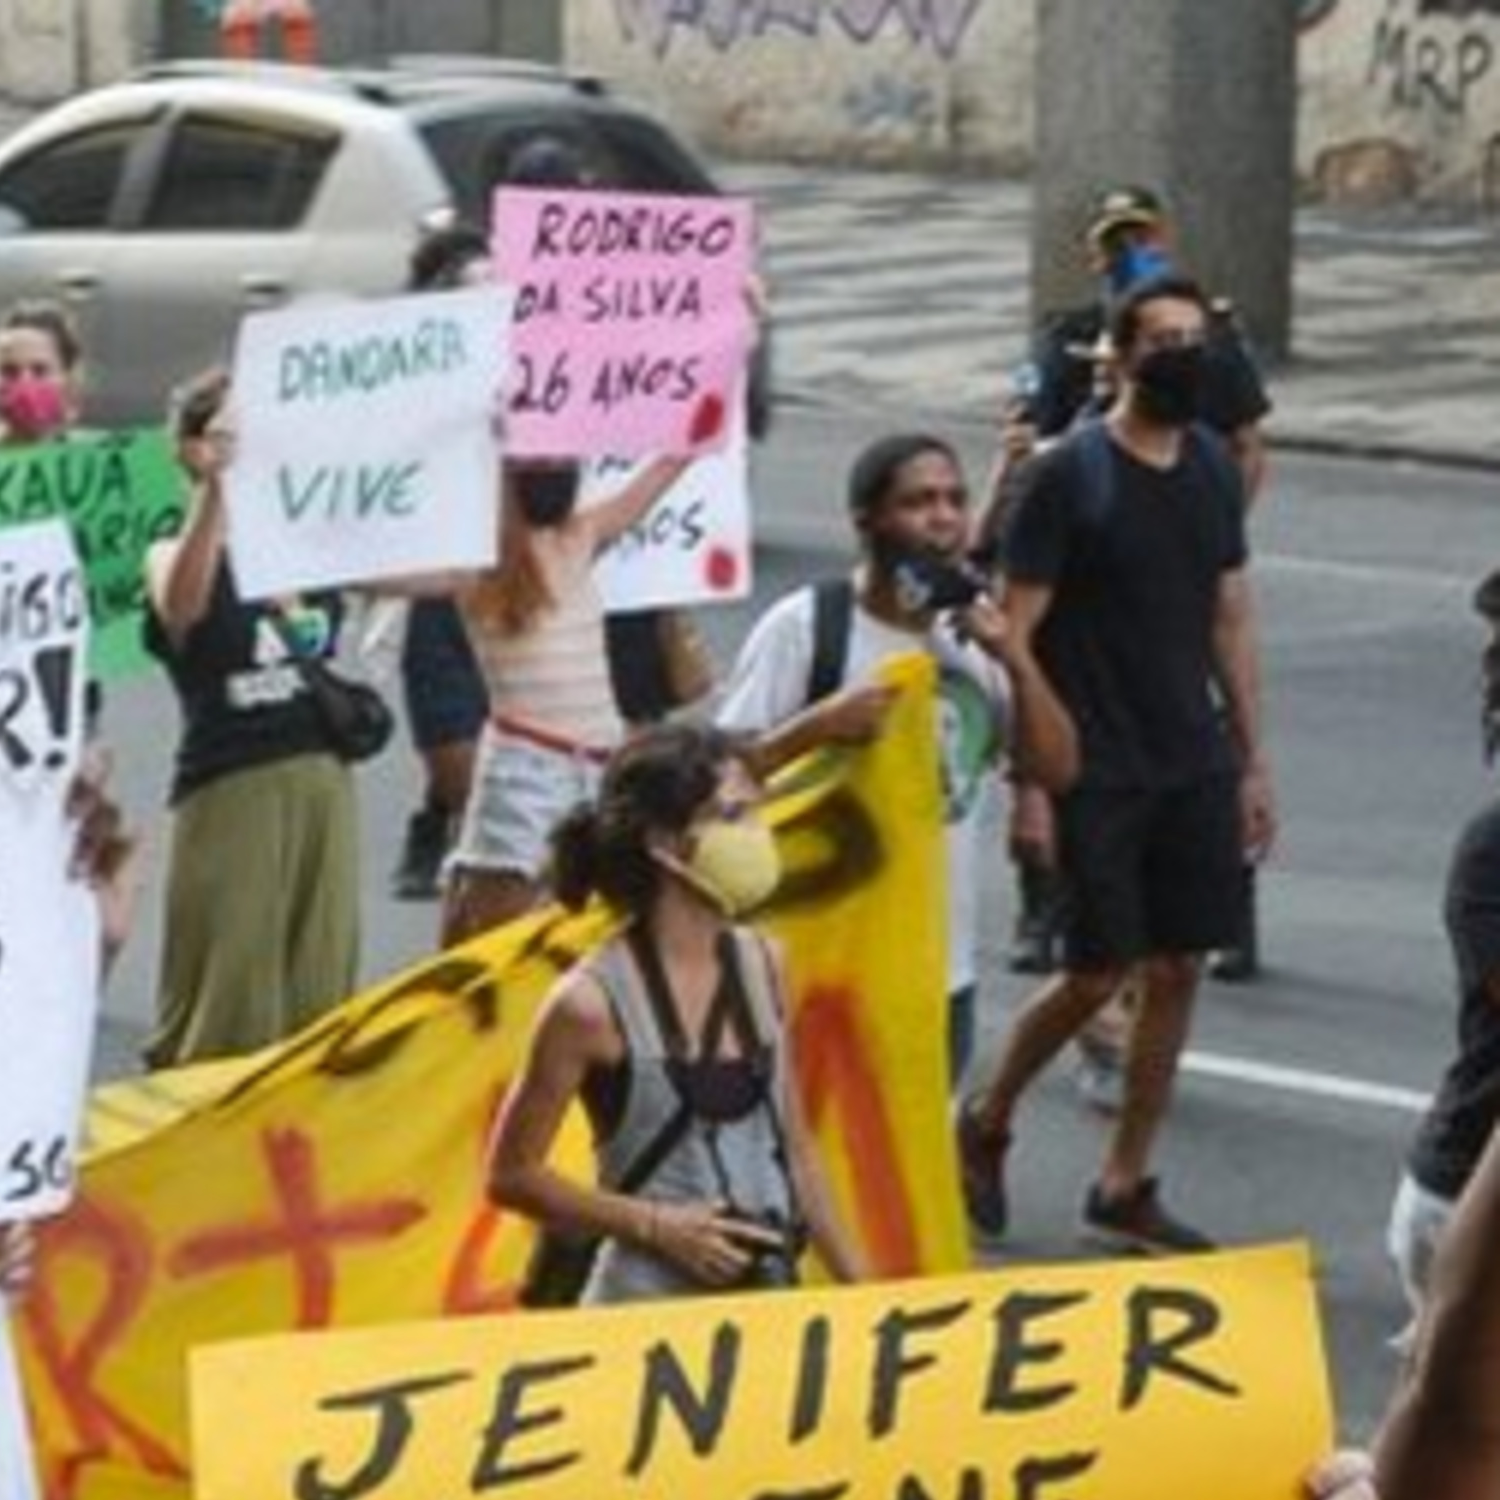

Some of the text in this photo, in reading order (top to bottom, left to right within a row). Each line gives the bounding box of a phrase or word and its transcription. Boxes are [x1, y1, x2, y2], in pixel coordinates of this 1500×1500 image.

[530, 200, 736, 260] RODRIGO
[513, 272, 700, 322] DA SILVA
[509, 352, 702, 414] 26 ANOS
[278, 460, 422, 522] VIVE
